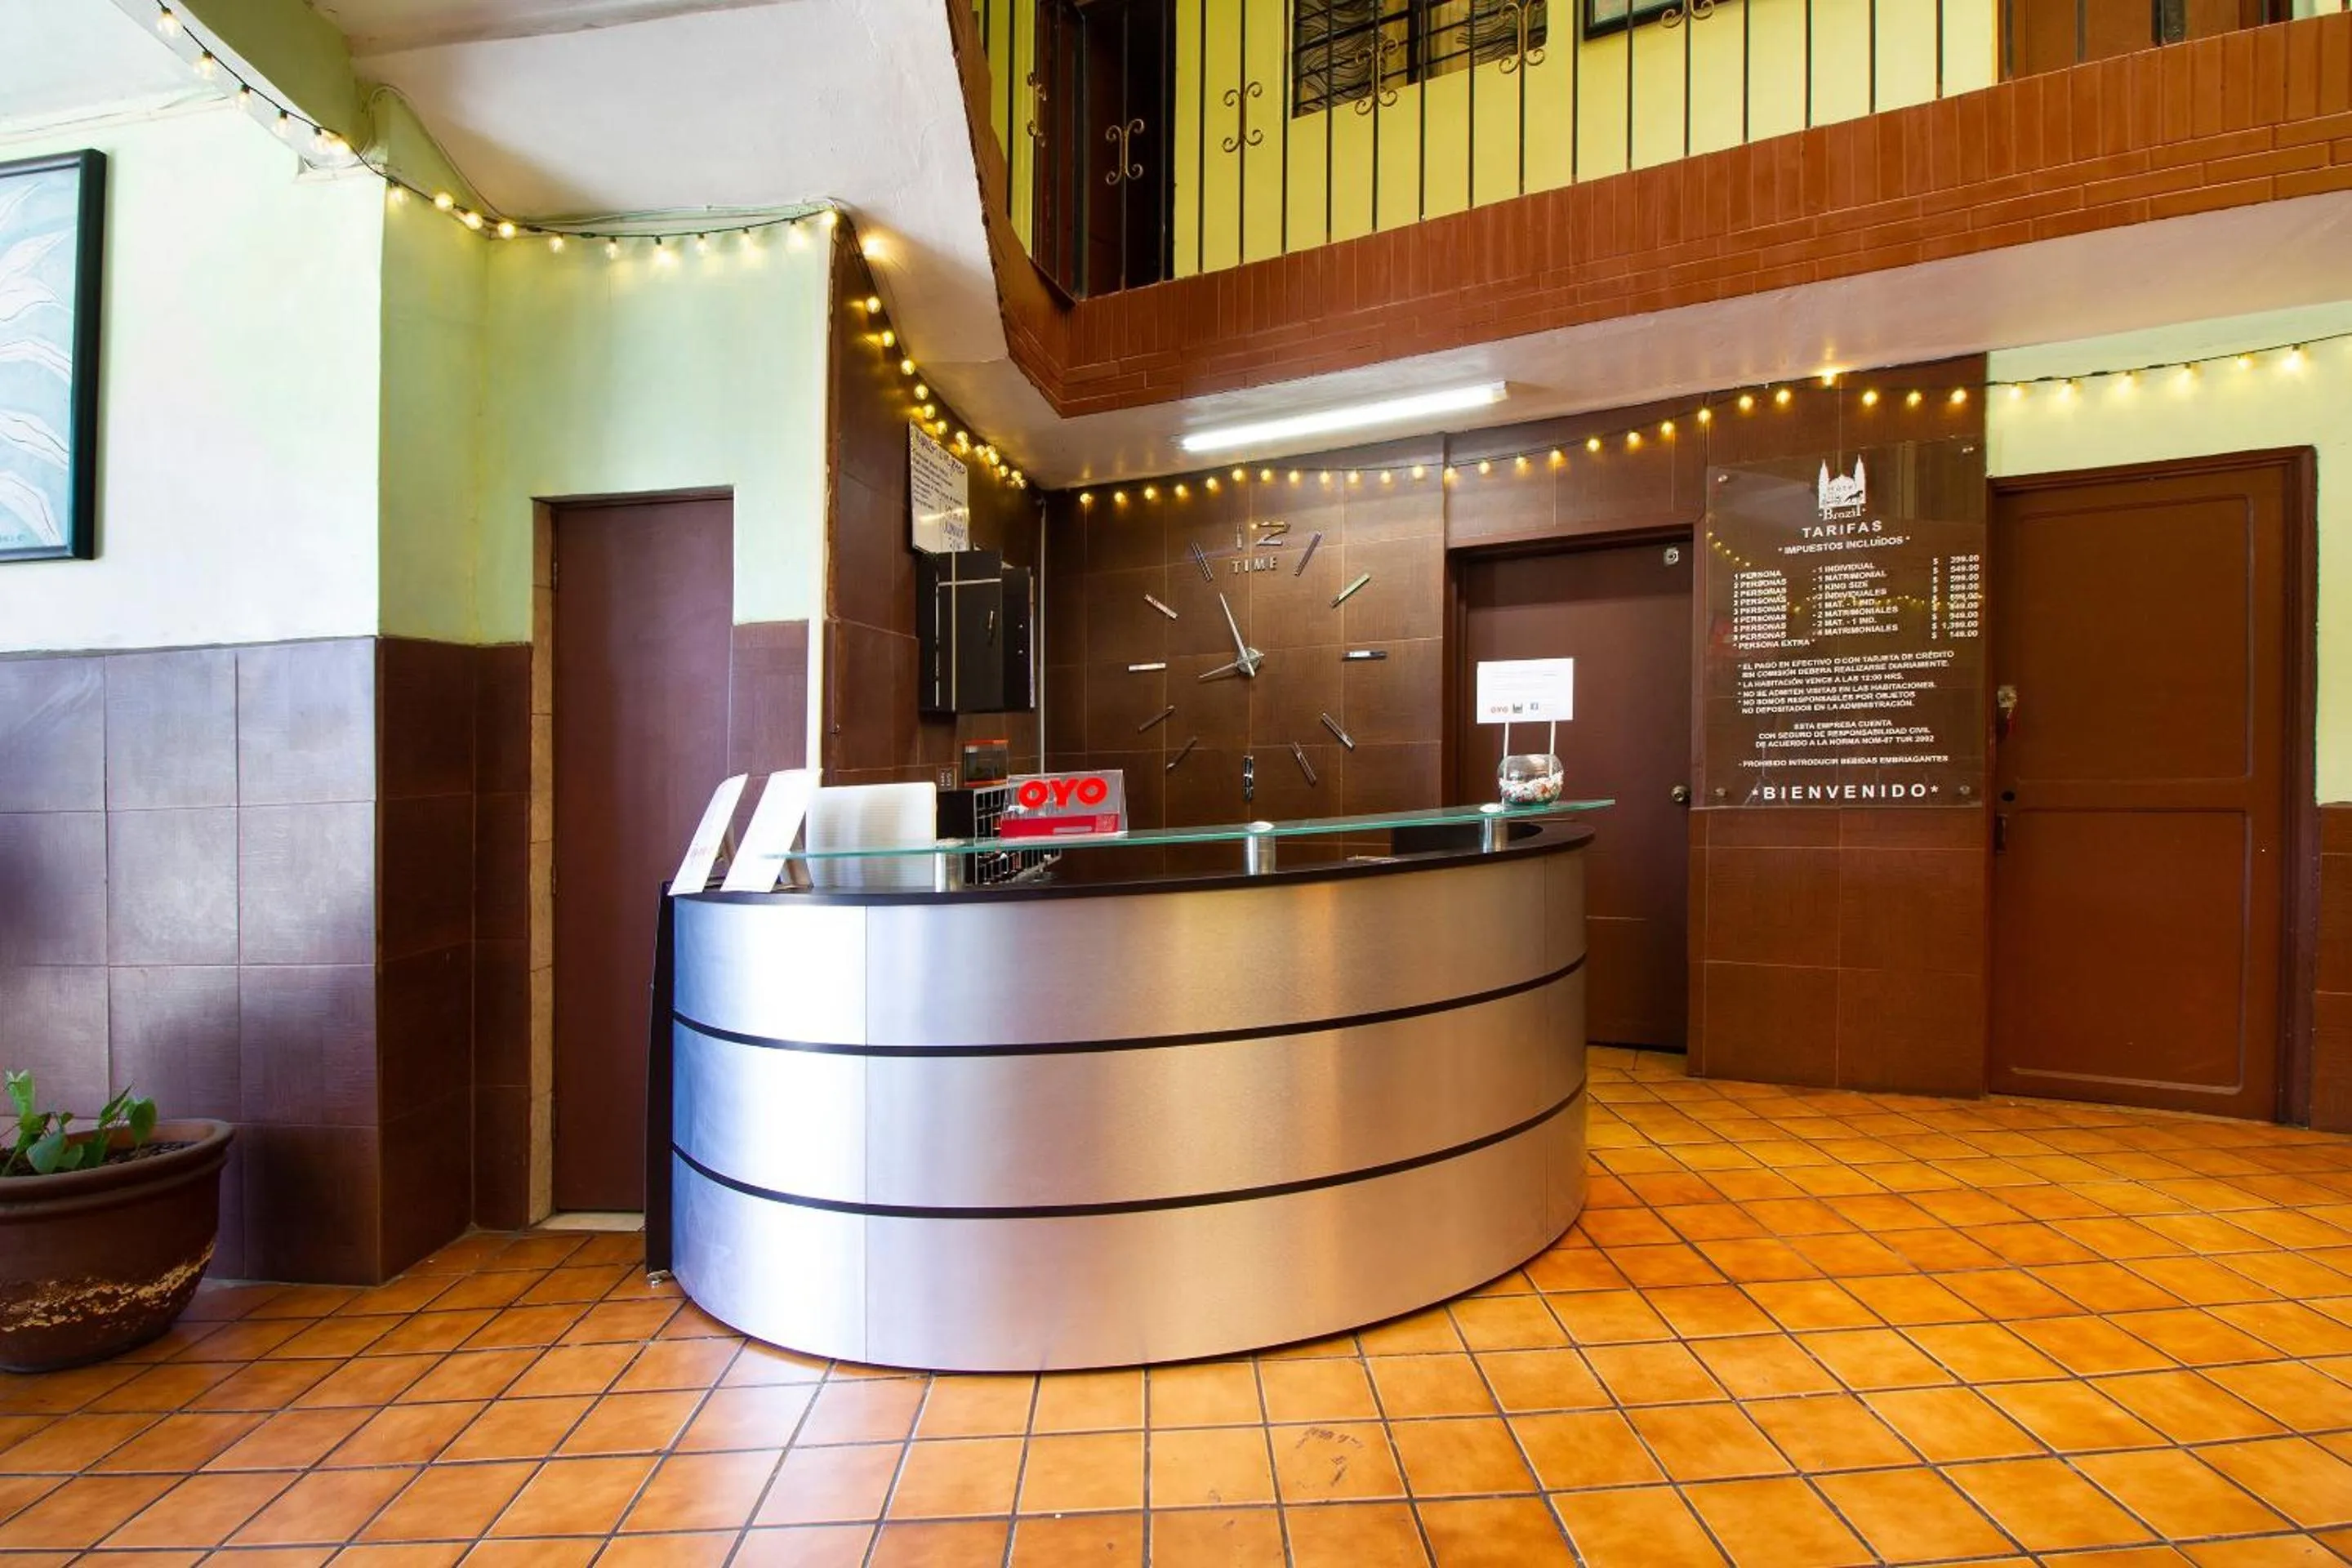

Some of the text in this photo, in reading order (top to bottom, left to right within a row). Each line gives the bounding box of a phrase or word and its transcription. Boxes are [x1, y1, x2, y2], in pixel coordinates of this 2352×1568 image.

[1822, 505, 1862, 520] Brazil
[1236, 521, 1291, 550] 12
[1802, 519, 1882, 538] TARIFAS
[1784, 541, 1843, 555] IMPUESTOS
[1232, 556, 1277, 574] TIME
[1740, 570, 1782, 580] PERSONA
[1824, 562, 1875, 572] INDIVIDUAL
[1740, 578, 1787, 588] PERSONAS
[1824, 570, 1886, 581] MATRIMONIAL
[1740, 588, 1787, 597] PERSONAS
[1849, 580, 1869, 589] SIZE
[1740, 596, 1787, 605] PERSONAS
[1824, 588, 1887, 599] INDIVIDUALES
[1740, 604, 1787, 614] PERSONAS
[1740, 614, 1787, 623] PERSONAS
[1824, 606, 1899, 617] MATRIMONIALES
[1740, 622, 1787, 632] PERSONAS
[1740, 631, 1787, 640] PERSONAS
[1824, 624, 1899, 635] MATRIMONIALES
[1738, 640, 1780, 650] PERSONA
[1780, 639, 1811, 647] EXTRA
[1754, 662, 1777, 670] PAGO
[1792, 658, 1832, 667] EFECTIVO
[1862, 654, 1900, 663] TARJETA
[1916, 650, 1954, 660] CRÉDITO
[1787, 694, 1854, 703] RESPONSABLES
[1855, 693, 1873, 701] POR
[1875, 691, 1916, 699] OBJETOS
[1858, 719, 1892, 728] CUENTA
[1827, 728, 1907, 737] RESPONSABILIDAD
[1743, 755, 1949, 768] PROHIBIDO INTRODUCIR BEBIDAS EMBRIAGANTES
[1018, 777, 1108, 808] OYO
[1764, 783, 1926, 800] BIENVENIDO
